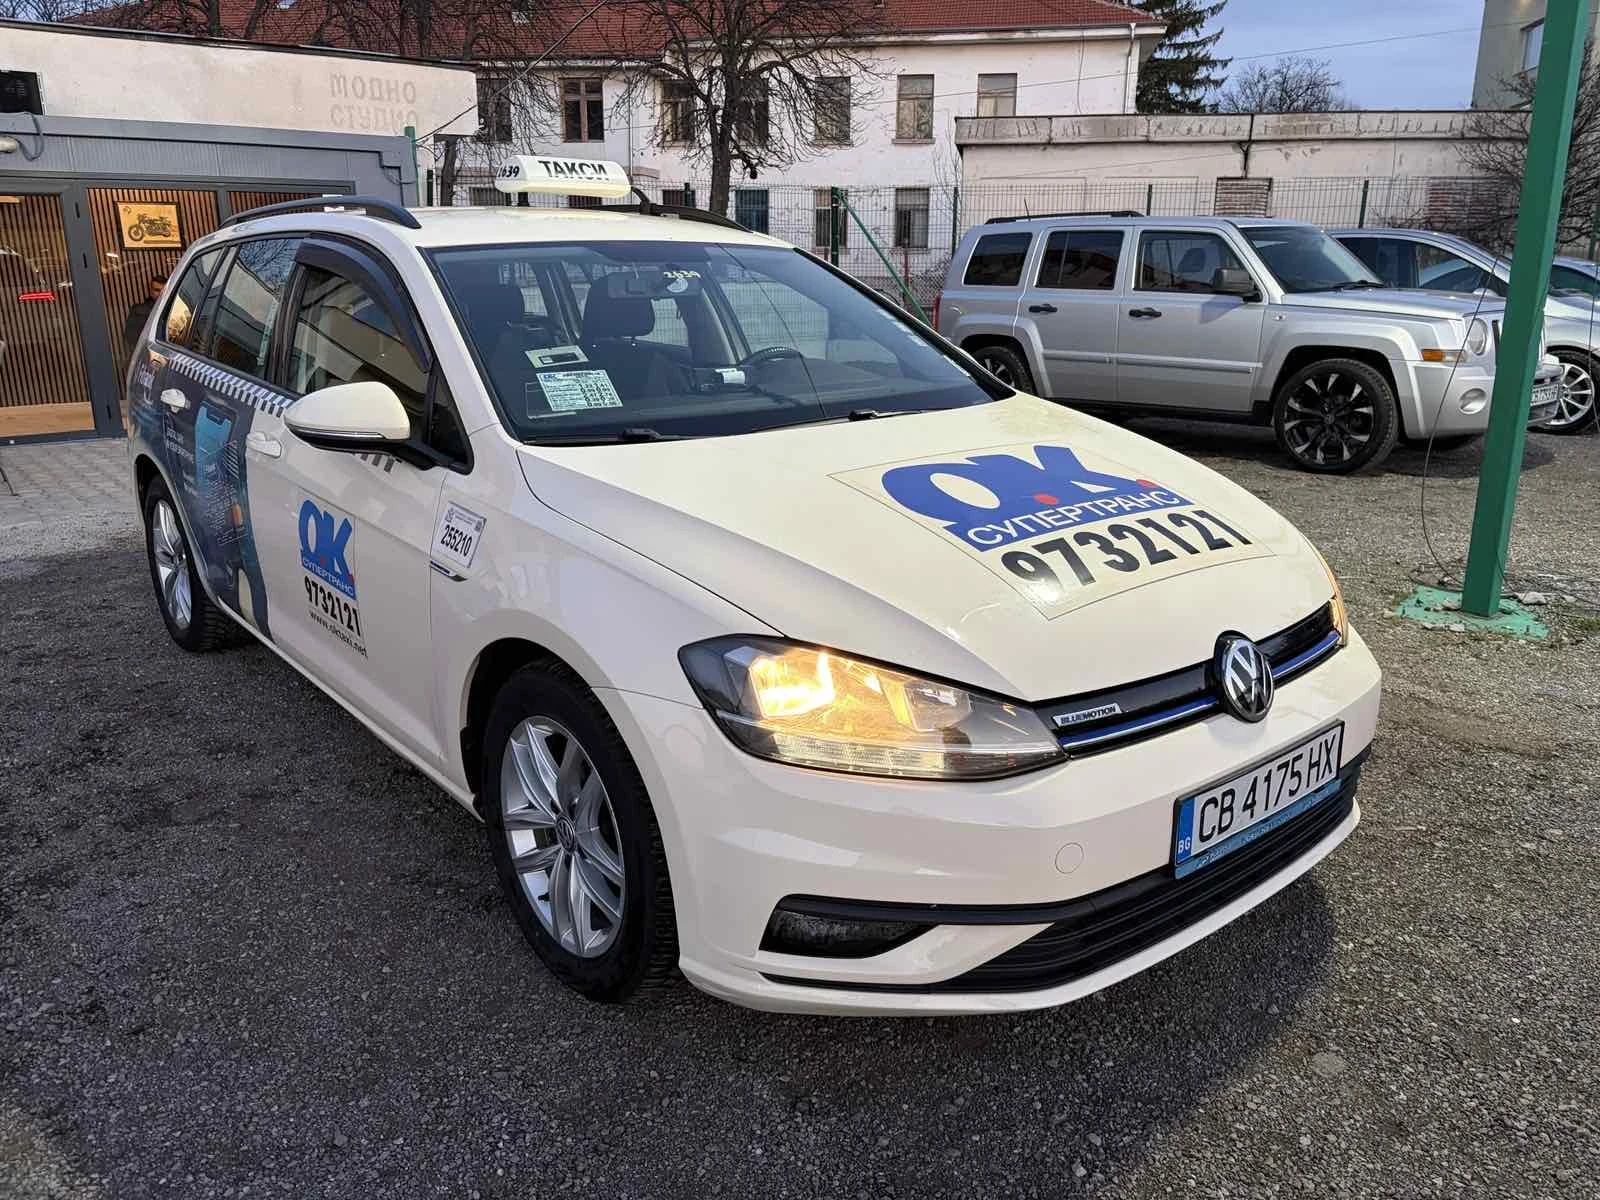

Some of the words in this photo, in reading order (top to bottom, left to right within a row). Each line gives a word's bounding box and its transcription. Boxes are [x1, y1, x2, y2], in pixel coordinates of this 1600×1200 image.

[329, 73, 417, 105] МОДНО
[538, 160, 610, 181] ТАКСИ
[967, 488, 1185, 547] СУПЕРТРАНС
[440, 524, 473, 557] 255210
[1000, 509, 1254, 600] 9732121
[304, 575, 361, 637] 9732121
[1060, 705, 1117, 725] BLUEMOTION
[1198, 788, 1236, 843] CB
[1241, 752, 1304, 820] 4175
[1305, 733, 1338, 789] HX
[1177, 836, 1192, 855] BG
